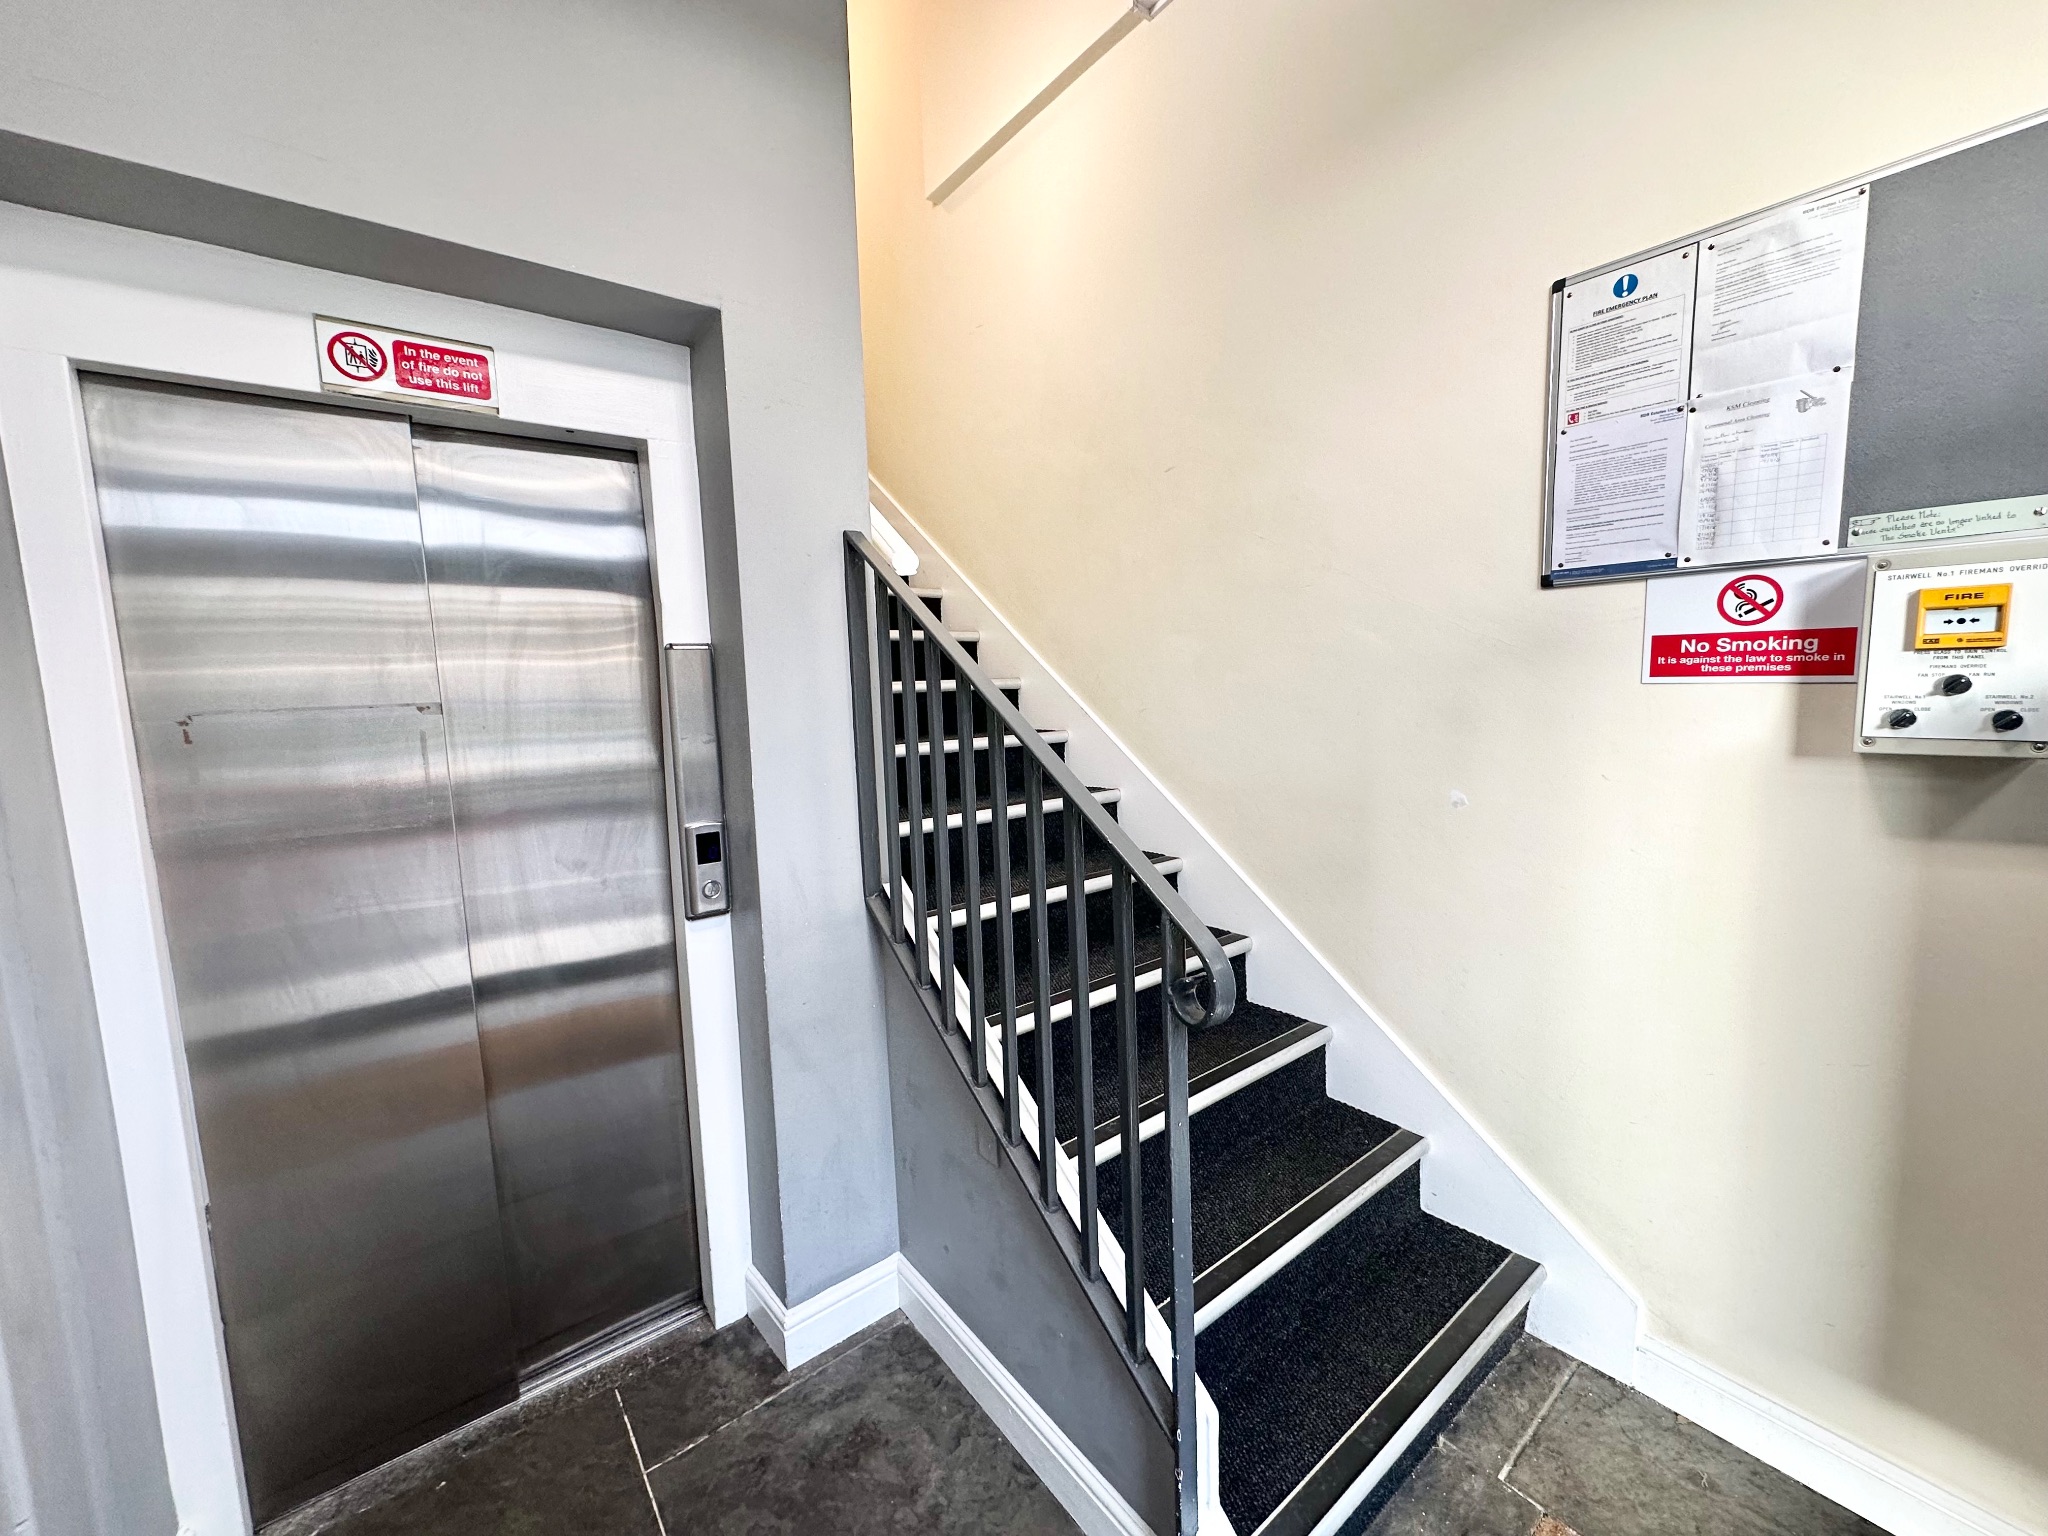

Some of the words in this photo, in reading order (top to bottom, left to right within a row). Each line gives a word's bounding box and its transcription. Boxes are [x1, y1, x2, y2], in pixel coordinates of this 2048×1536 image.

[1592, 308, 1605, 317] FIRE
[1605, 298, 1641, 313] EMERGENCY
[1641, 292, 1659, 302] PLAN
[403, 345, 417, 357] In
[419, 349, 441, 361] the
[444, 355, 479, 368] event
[401, 360, 415, 370] of
[418, 360, 440, 374] fire
[443, 366, 460, 378] do
[462, 370, 483, 382] not
[408, 376, 433, 387] use
[436, 379, 460, 391] this
[462, 382, 480, 394] lift
[1879, 523, 1917, 533] switches
[1919, 520, 1933, 528] are
[1948, 515, 1973, 529] longer
[1976, 512, 2002, 522] linked
[2007, 510, 2017, 519] to
[1886, 511, 1915, 523] Please
[1880, 533, 1895, 542] The
[1897, 530, 1927, 540] Smoke
[1930, 526, 1957, 536] Vents
[1887, 571, 1931, 581] STAIRWELL
[1936, 570, 1955, 578] No.1
[1959, 566, 2004, 576] FIREMANS
[1944, 592, 1984, 601] FIRE
[1680, 639, 1710, 654] No
[1716, 635, 1819, 654] Smoking
[1657, 656, 1666, 664] It
[1667, 655, 1677, 664] is
[1679, 654, 1721, 666] against
[1723, 655, 1742, 663] the
[1745, 654, 1766, 663] law
[1770, 653, 1783, 662] to
[1786, 652, 1830, 662] smoke
[1833, 652, 1845, 661] in
[1700, 663, 1733, 673] these
[1735, 662, 1792, 674] premises
